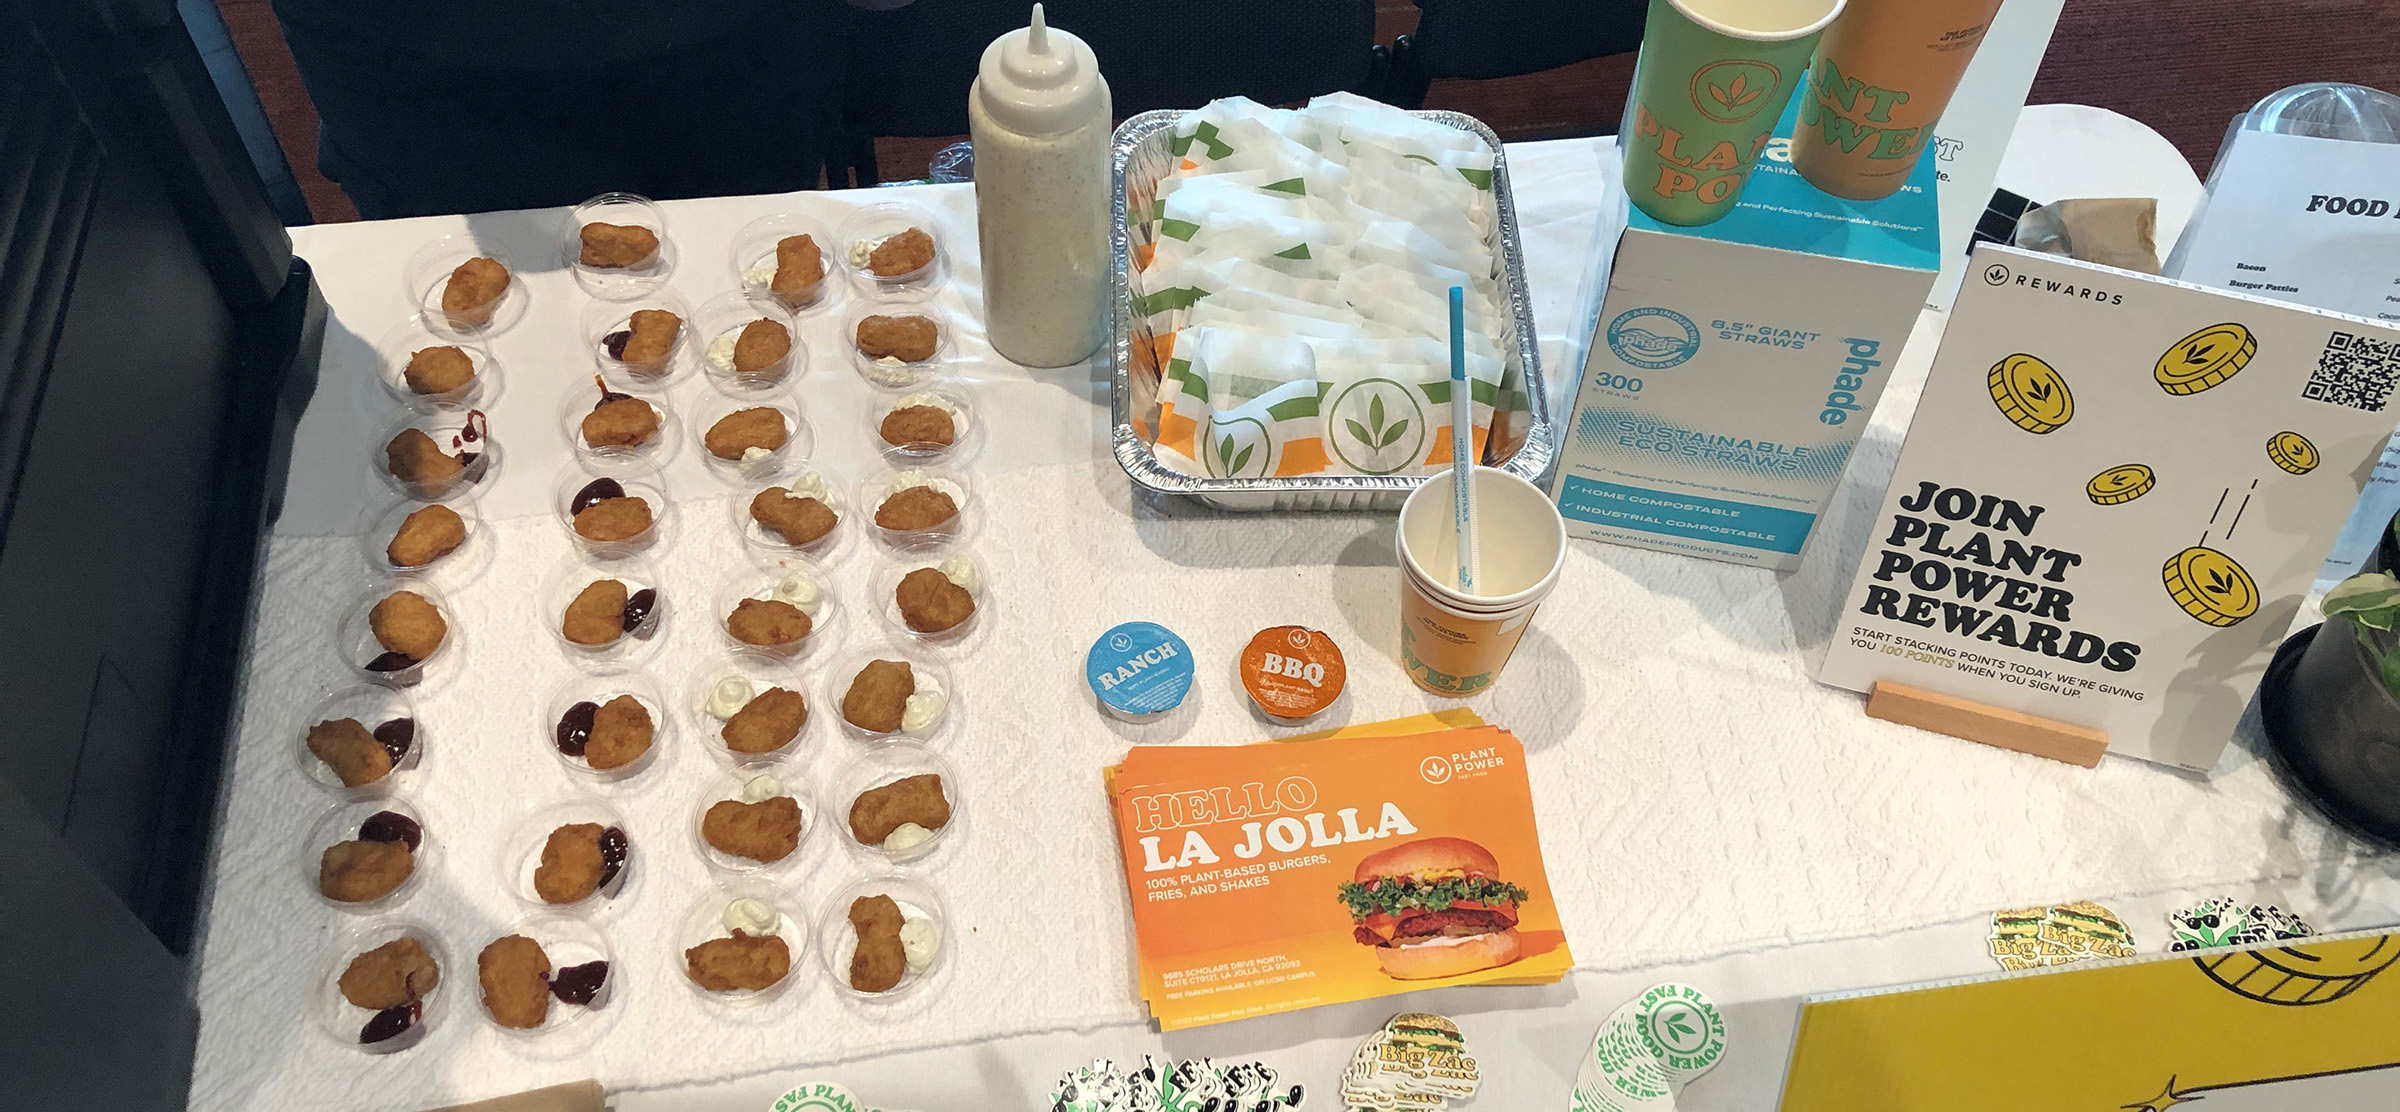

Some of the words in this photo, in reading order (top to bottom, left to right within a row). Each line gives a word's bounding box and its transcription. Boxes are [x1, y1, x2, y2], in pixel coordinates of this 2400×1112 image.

[1762, 204, 1813, 218] Perfecting
[1814, 212, 1870, 225] Sustainable
[2306, 195, 2389, 217] FOOD
[2236, 263, 2266, 272] Bacon
[2016, 275, 2122, 305] REWARDS
[2229, 280, 2263, 290] Burger
[2265, 283, 2299, 293] Patties
[1611, 313, 1632, 334] HOME
[1660, 309, 1698, 348] INDUSTRIAL
[1622, 333, 1678, 351] phade
[1719, 331, 1805, 350] STRAWS
[1758, 327, 1821, 341] GIANT
[1610, 344, 1686, 368] COMPOSTABLE
[1591, 387, 1640, 400] STRAWS
[1595, 372, 1643, 393] 300
[1820, 338, 1881, 425] phade
[1618, 420, 1811, 458] SUSTAINABLE
[1618, 436, 1674, 452] ECO
[1681, 446, 1800, 471] STRAWS
[1582, 487, 1625, 501] HOME
[1629, 496, 1741, 518] COMPOSTABLE
[1899, 481, 2045, 537] JOIN
[1576, 504, 1662, 525] INDUSTRIAL
[1666, 520, 1776, 542] COMPOSTABLE
[1886, 514, 2082, 582] PLANT
[1873, 550, 2074, 622] POWER
[1859, 585, 2141, 672] REWARDS
[1098, 642, 1178, 691] RANCH
[1262, 652, 1325, 688] BBQ
[1849, 637, 1876, 650] YOU
[1879, 643, 1902, 656] 100
[1904, 650, 1955, 669] POINTS
[1957, 662, 1996, 679] WHEN
[1999, 671, 2026, 686] YOU
[2028, 680, 2060, 695] SIGN
[2062, 686, 2082, 699] UP.
[1853, 626, 1893, 642] START
[1894, 636, 1957, 658] STACKING
[1959, 651, 2006, 670] POINTS
[2009, 663, 2052, 681] TODAY.
[2056, 673, 2097, 690] WE'RE
[2098, 684, 2144, 701] GIVING
[1452, 747, 1495, 763] PLANT
[1455, 757, 1504, 773] POWER
[1133, 776, 1317, 832] HELLO
[1139, 831, 1220, 872] LA
[1234, 802, 1418, 858] JOLLA
[1146, 876, 1178, 890] 100%
[1180, 863, 1266, 885] PLANT-BASED
[1269, 854, 1331, 872] BURGERS,
[1148, 889, 1187, 902] FRIES,
[1190, 883, 1219, 897] AND
[1220, 875, 1270, 892] SHAKES
[1990, 938, 2037, 960] Big
[2037, 939, 2075, 956] Za
[2042, 923, 2086, 952] Big
[2089, 936, 2137, 958] Zac
[1163, 979, 1187, 988] SUITE
[1220, 970, 1231, 980] LA
[1262, 964, 1274, 973] CA
[1275, 960, 1301, 971] 92093
[1185, 964, 1229, 978] SCHOLARS
[1230, 959, 1255, 970] DRIVE
[1166, 992, 1183, 1000] FREE
[1184, 987, 1214, 998] PARKING
[1215, 981, 1251, 993] AVAILABLE
[1639, 984, 1678, 1013] FAST
[1682, 986, 1725, 1038] PLANT
[1635, 1013, 1664, 1058] FOOD
[1379, 1042, 1425, 1069] Big
[1428, 1050, 1477, 1071] Zac
[1669, 1039, 1723, 1070] POWER
